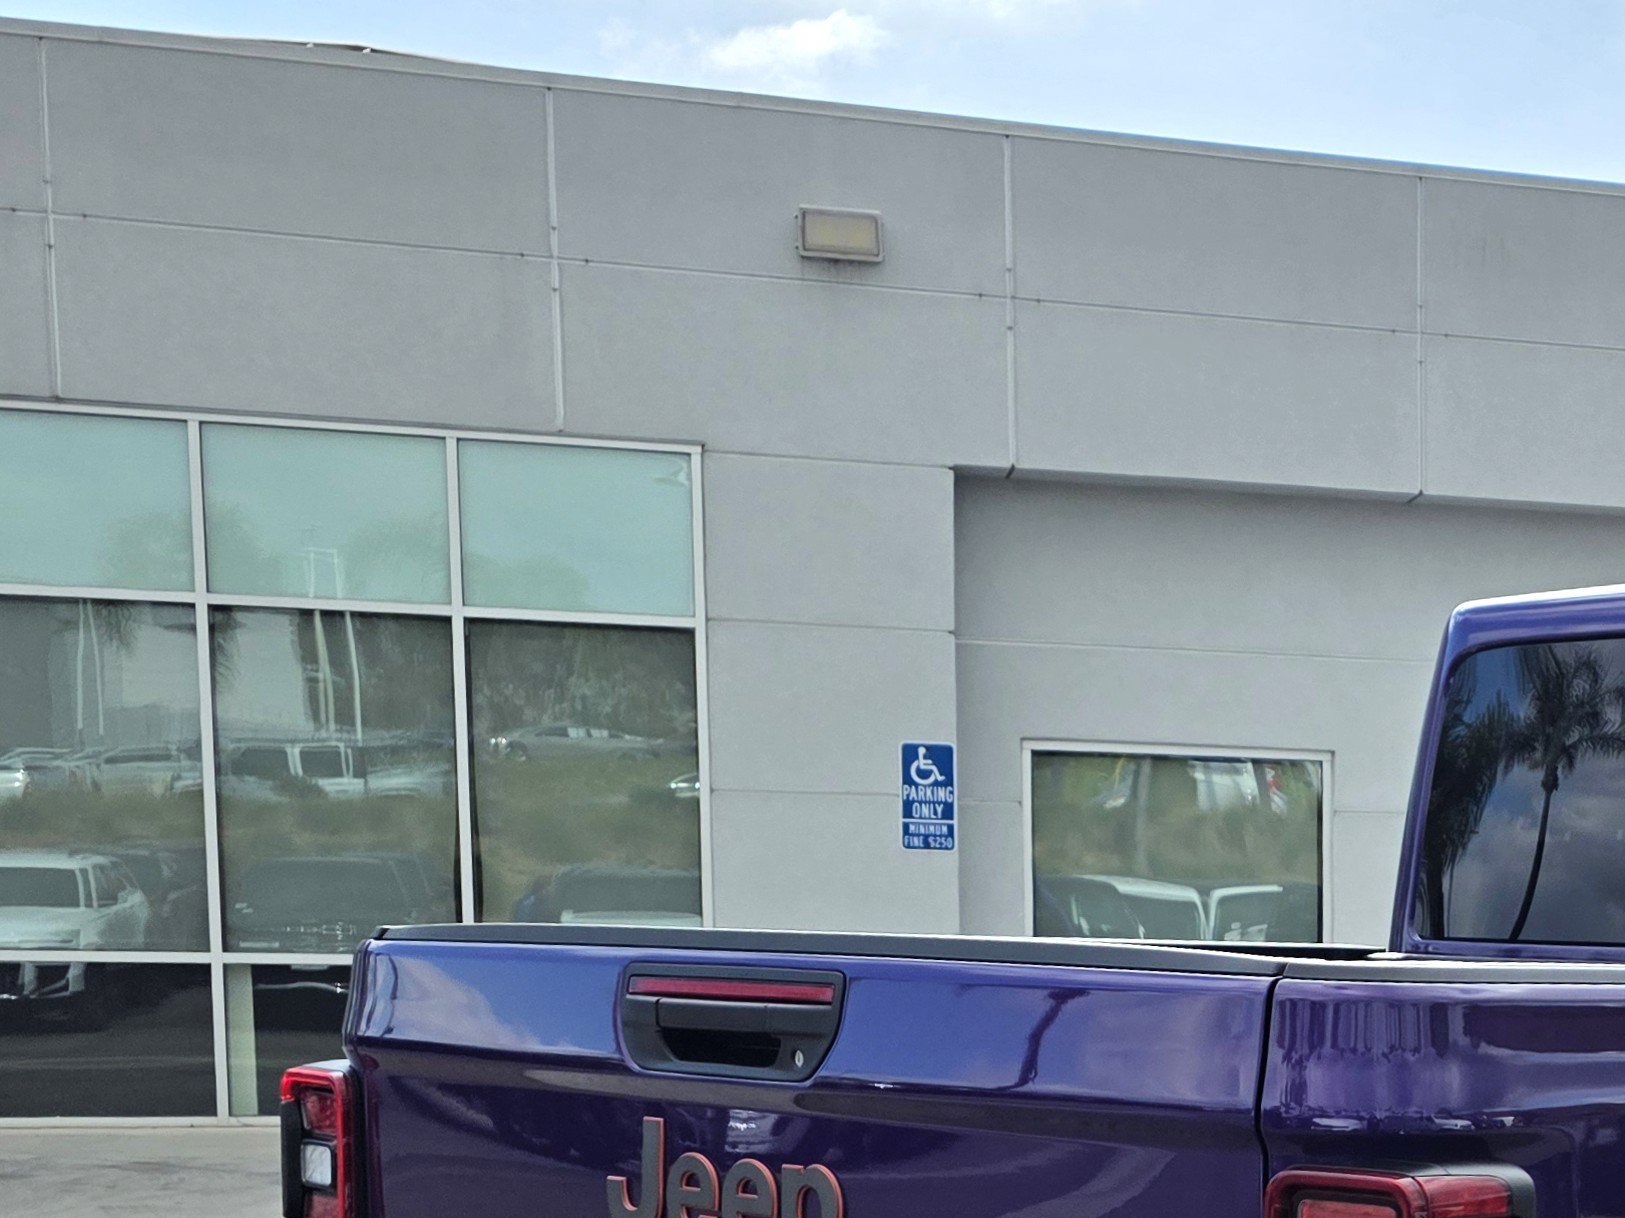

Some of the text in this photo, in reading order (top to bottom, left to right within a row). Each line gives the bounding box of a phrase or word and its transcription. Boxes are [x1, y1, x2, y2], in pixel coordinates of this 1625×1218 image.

[903, 784, 954, 803] PARKING
[912, 802, 944, 819] ONLY
[909, 823, 948, 835] MINIMUM
[904, 835, 953, 849] FINE $250
